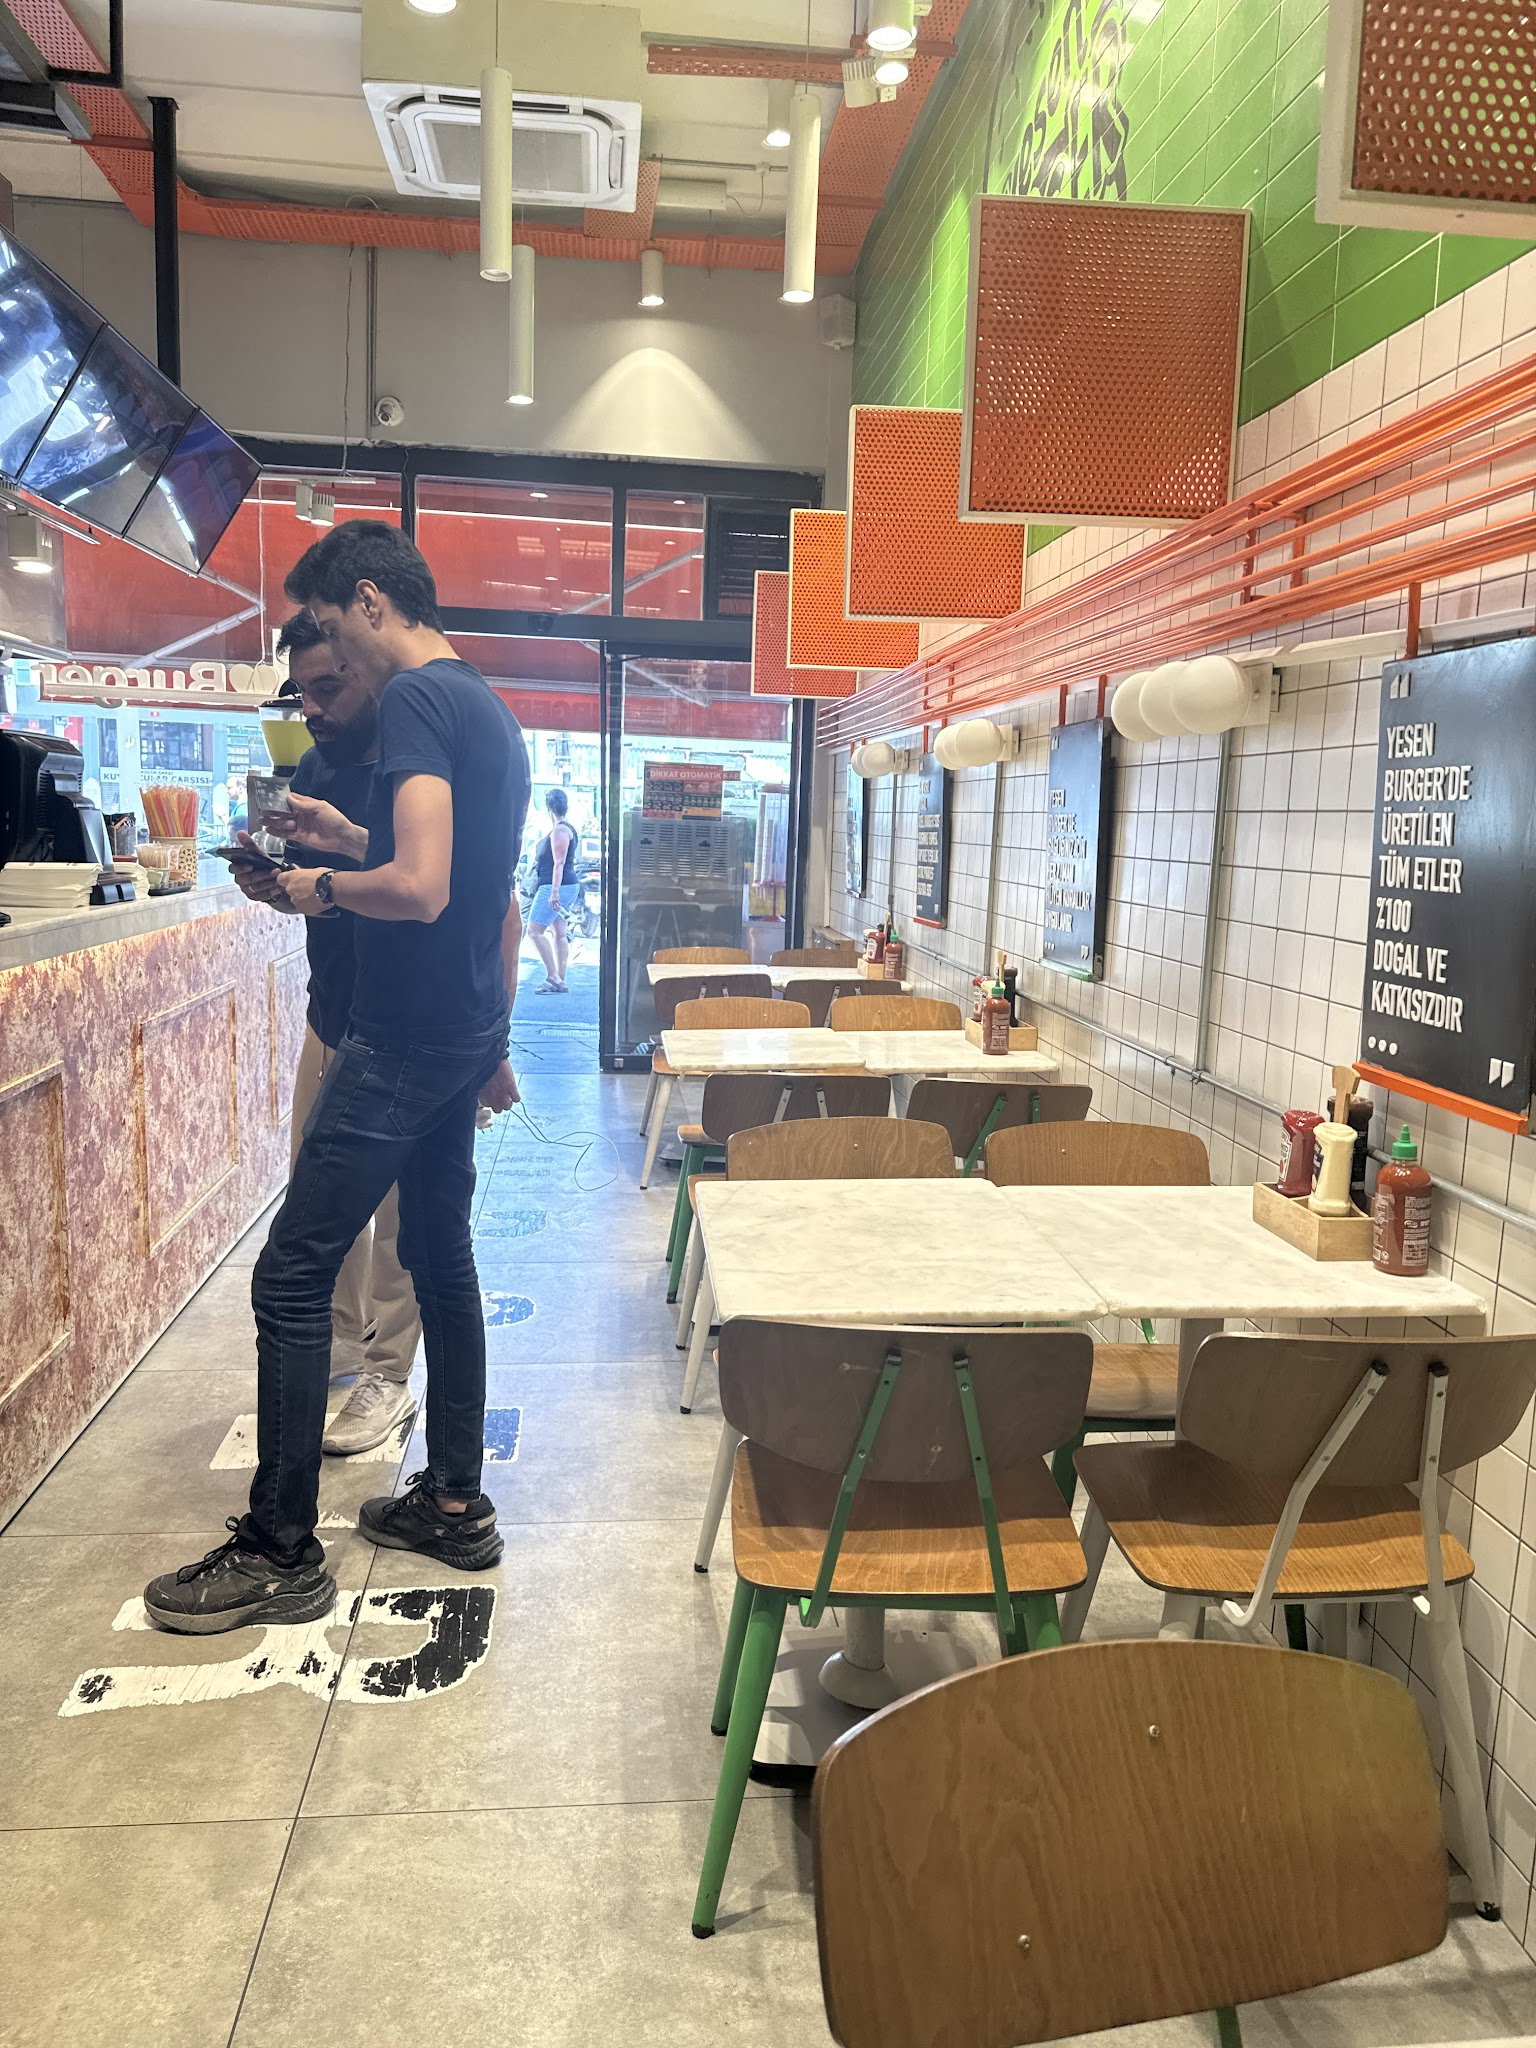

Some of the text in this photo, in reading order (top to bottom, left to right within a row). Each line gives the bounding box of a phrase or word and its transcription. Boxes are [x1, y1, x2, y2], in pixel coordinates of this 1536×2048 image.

[1387, 722, 1435, 759] YESEN
[650, 769, 679, 779] DİKKAT
[680, 770, 722, 779] OTOMATİK
[1383, 765, 1472, 801] BURGER'DE
[1381, 806, 1455, 847] ÜRETİLEN
[1379, 850, 1463, 894] TÜM ETLER
[1375, 896, 1411, 933] %100
[1426, 947, 1449, 984] VE
[1371, 980, 1463, 1033] KATKISIZDIR
